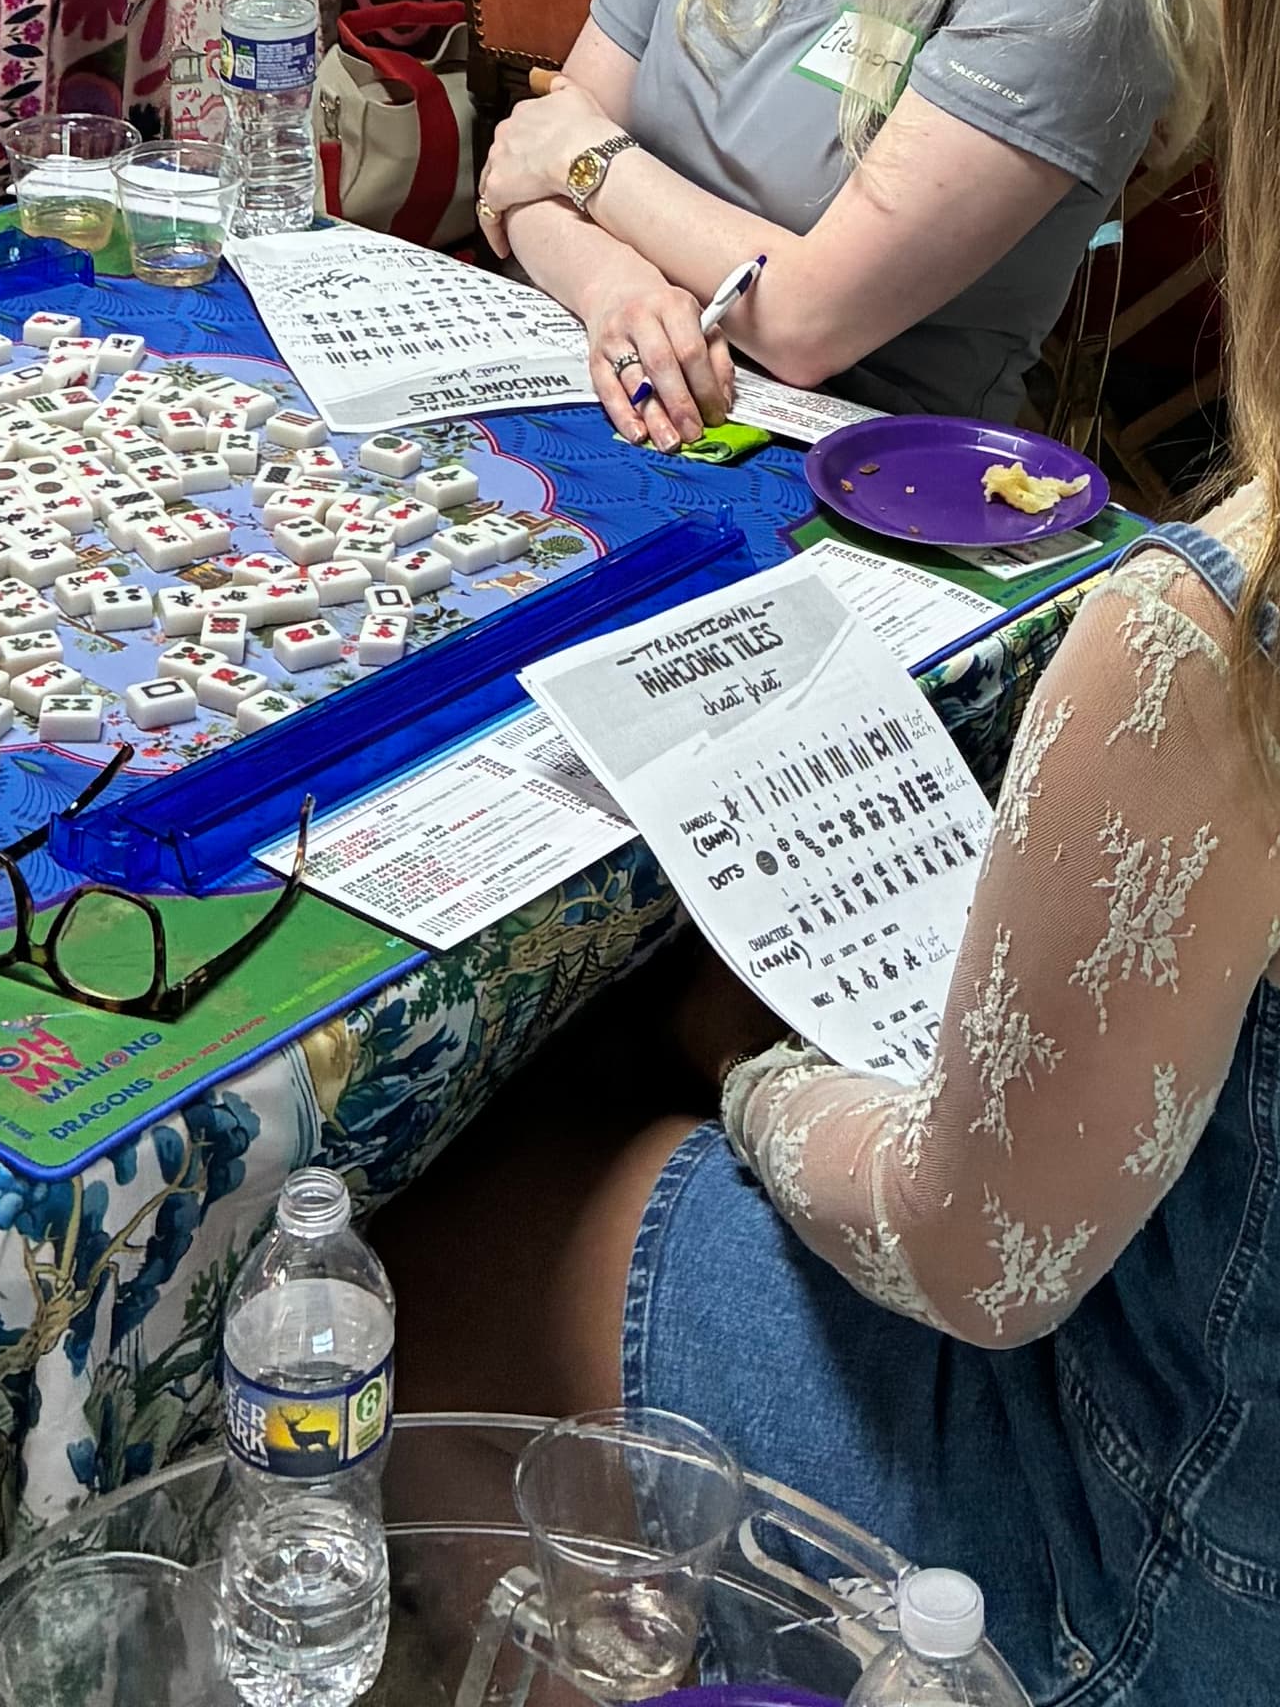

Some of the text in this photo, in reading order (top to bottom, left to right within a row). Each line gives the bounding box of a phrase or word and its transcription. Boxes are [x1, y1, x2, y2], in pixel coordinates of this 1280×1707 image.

[949, 59, 1025, 106] SKECHERS
[408, 375, 572, 406] MAHJONG TILES
[635, 622, 783, 699] MAHJONG TILES
[707, 863, 745, 890] DOTS
[10, 1044, 83, 1096] MY
[41, 1031, 164, 1105] MAHJONG
[49, 1076, 155, 1141] DRAGONS
[229, 1386, 266, 1430] EER
[227, 1410, 266, 1456] ARK
